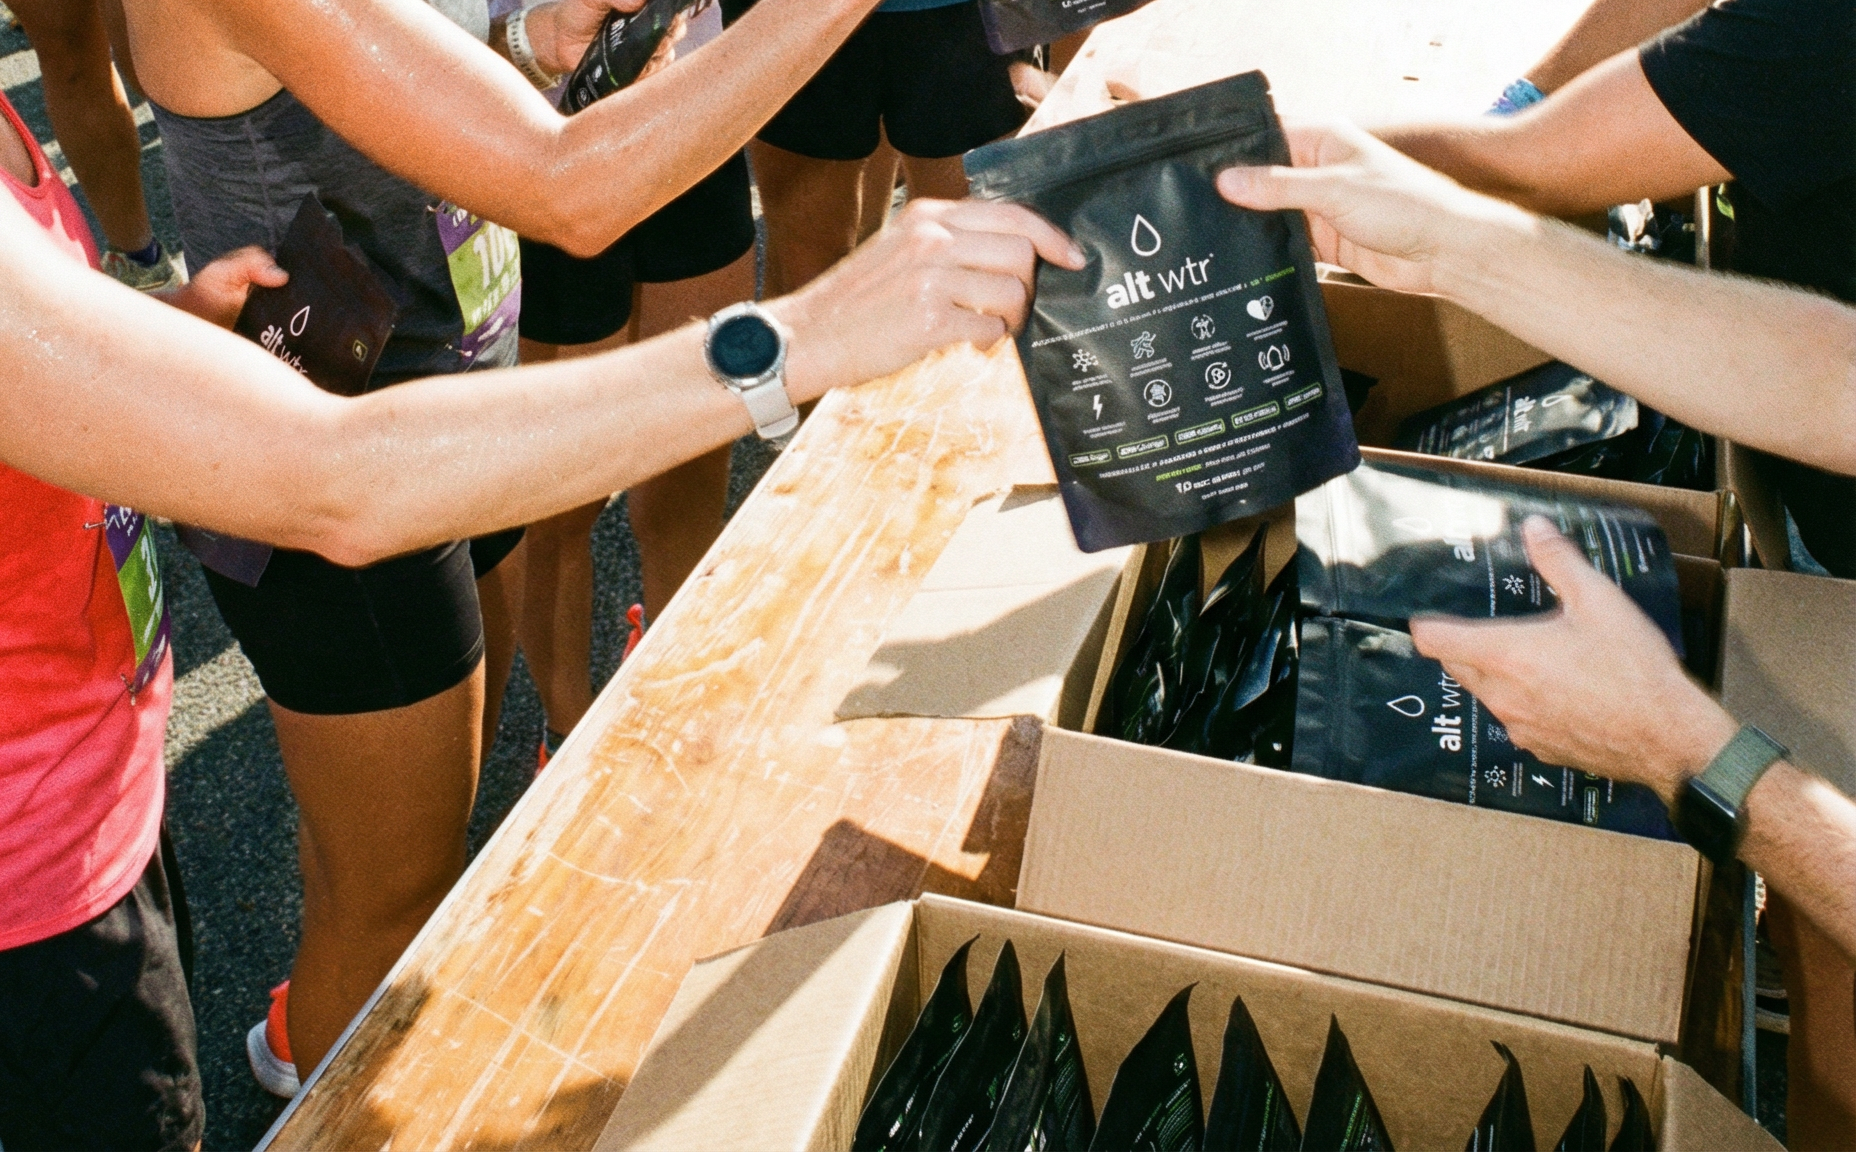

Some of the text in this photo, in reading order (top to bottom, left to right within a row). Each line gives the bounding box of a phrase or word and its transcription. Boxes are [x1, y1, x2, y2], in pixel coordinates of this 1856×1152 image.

[1105, 269, 1156, 310] alt
[1157, 255, 1211, 295] wtr
[260, 325, 284, 354] alt
[1431, 714, 1462, 752] alt
